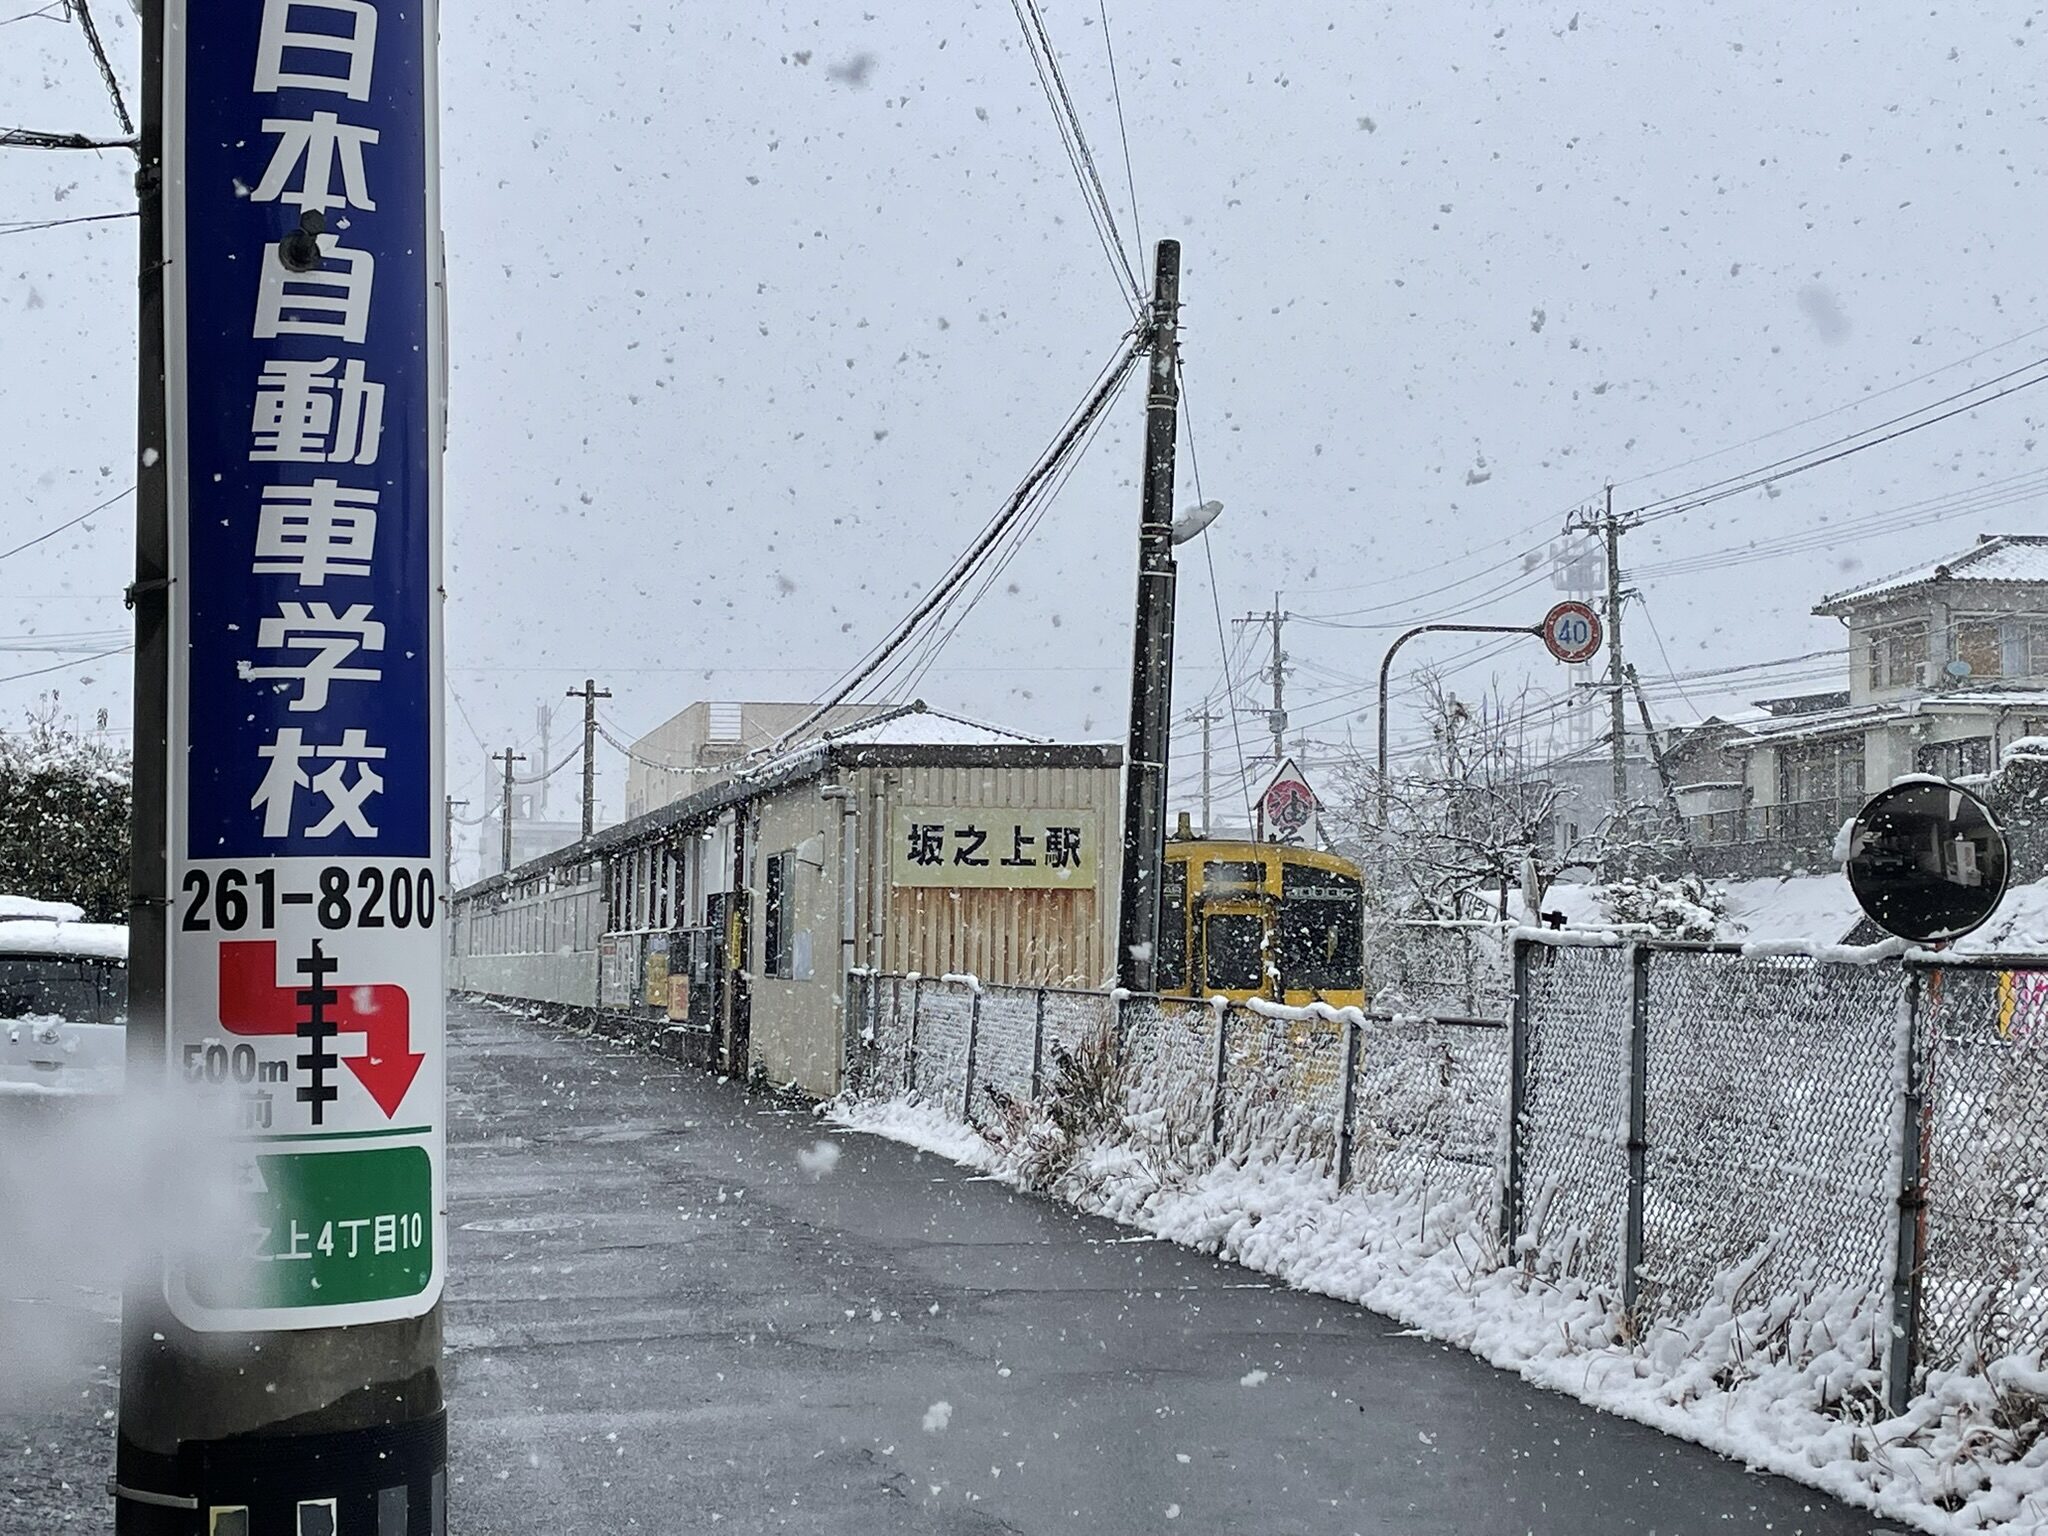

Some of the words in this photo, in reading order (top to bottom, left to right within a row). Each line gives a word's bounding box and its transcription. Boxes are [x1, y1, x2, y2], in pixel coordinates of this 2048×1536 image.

[249, 0, 387, 839] 日本自動車学校
[1558, 619, 1588, 645] 40
[907, 823, 1082, 869] 坂之上駅
[181, 866, 436, 933] 261-8200
[182, 1043, 289, 1083] 500m
